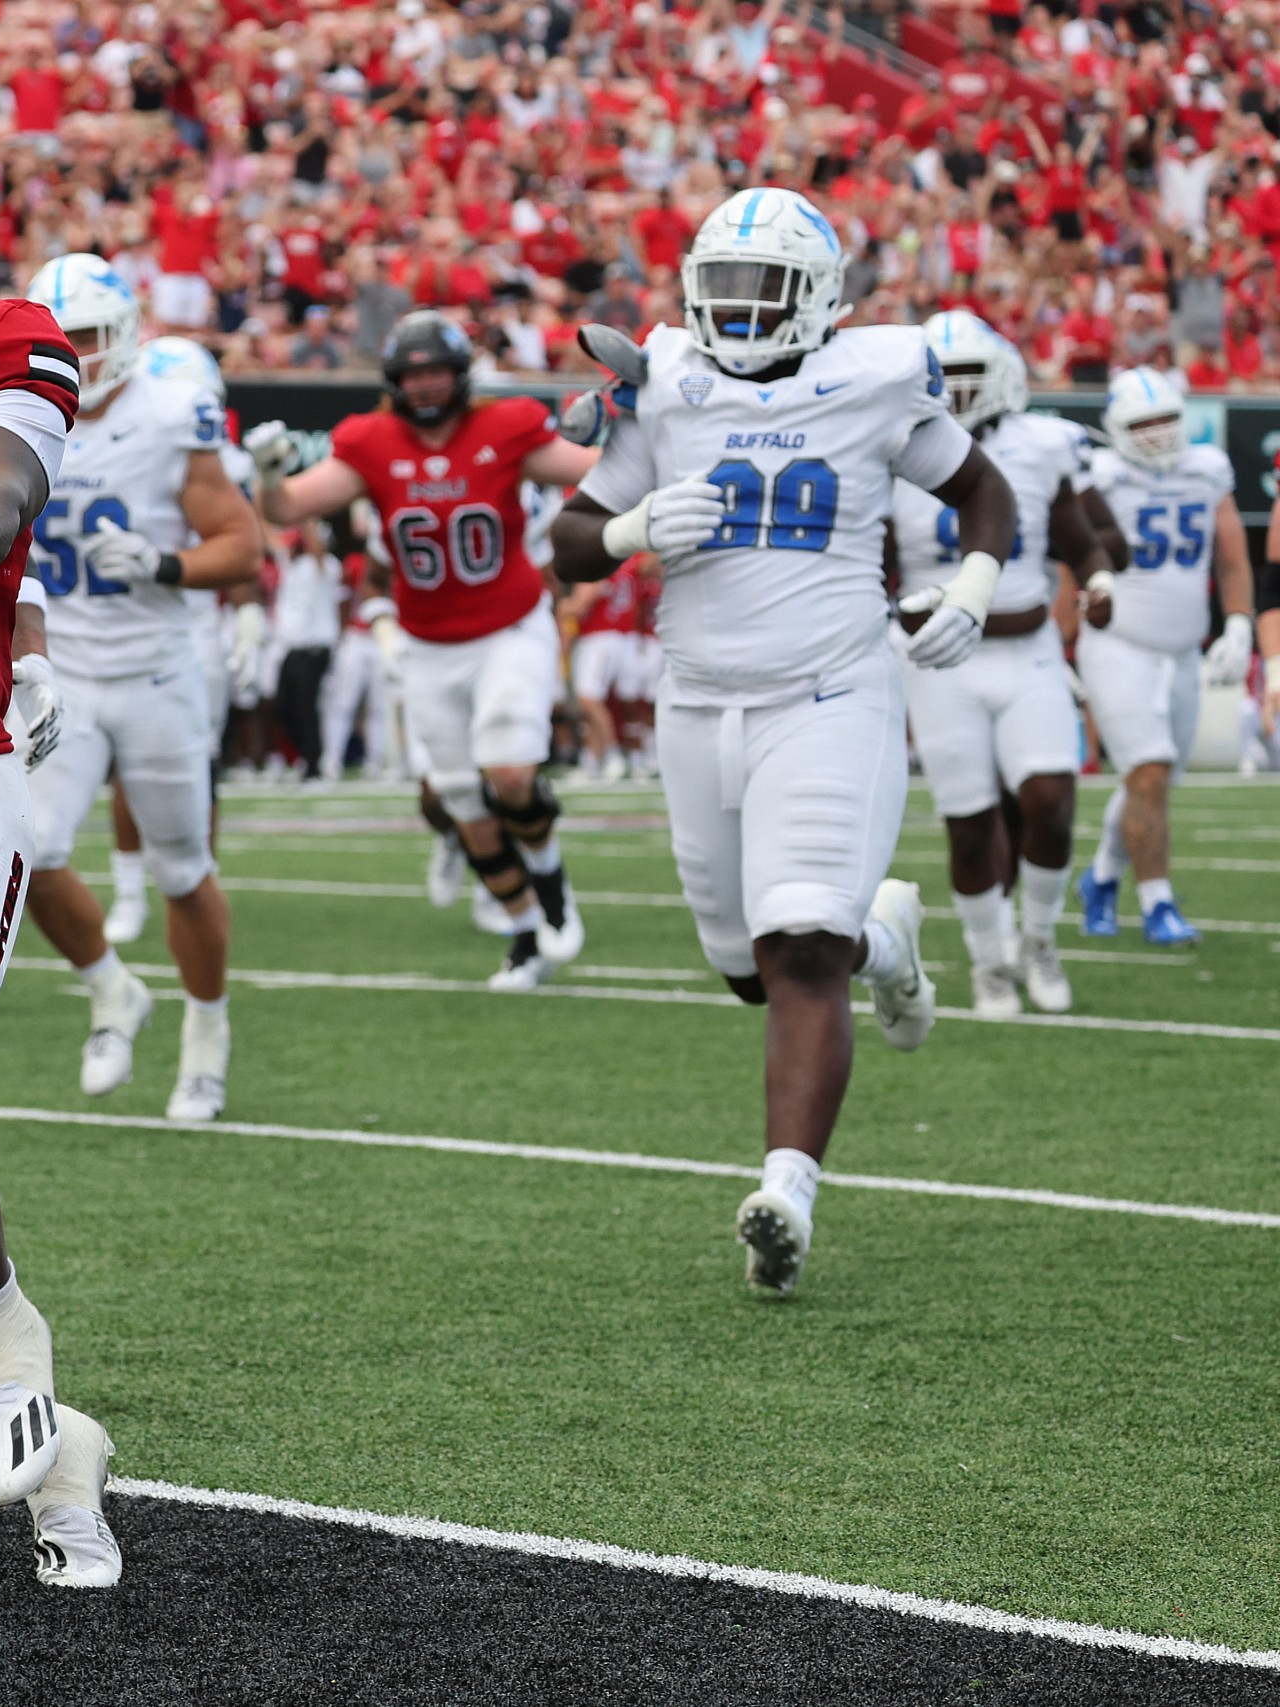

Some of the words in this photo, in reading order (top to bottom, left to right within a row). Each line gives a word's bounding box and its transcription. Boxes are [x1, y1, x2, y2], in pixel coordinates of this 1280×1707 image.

[725, 432, 806, 449] BUFFALO
[33, 497, 131, 596] 52
[390, 503, 504, 592] 60
[1134, 502, 1207, 570] 55
